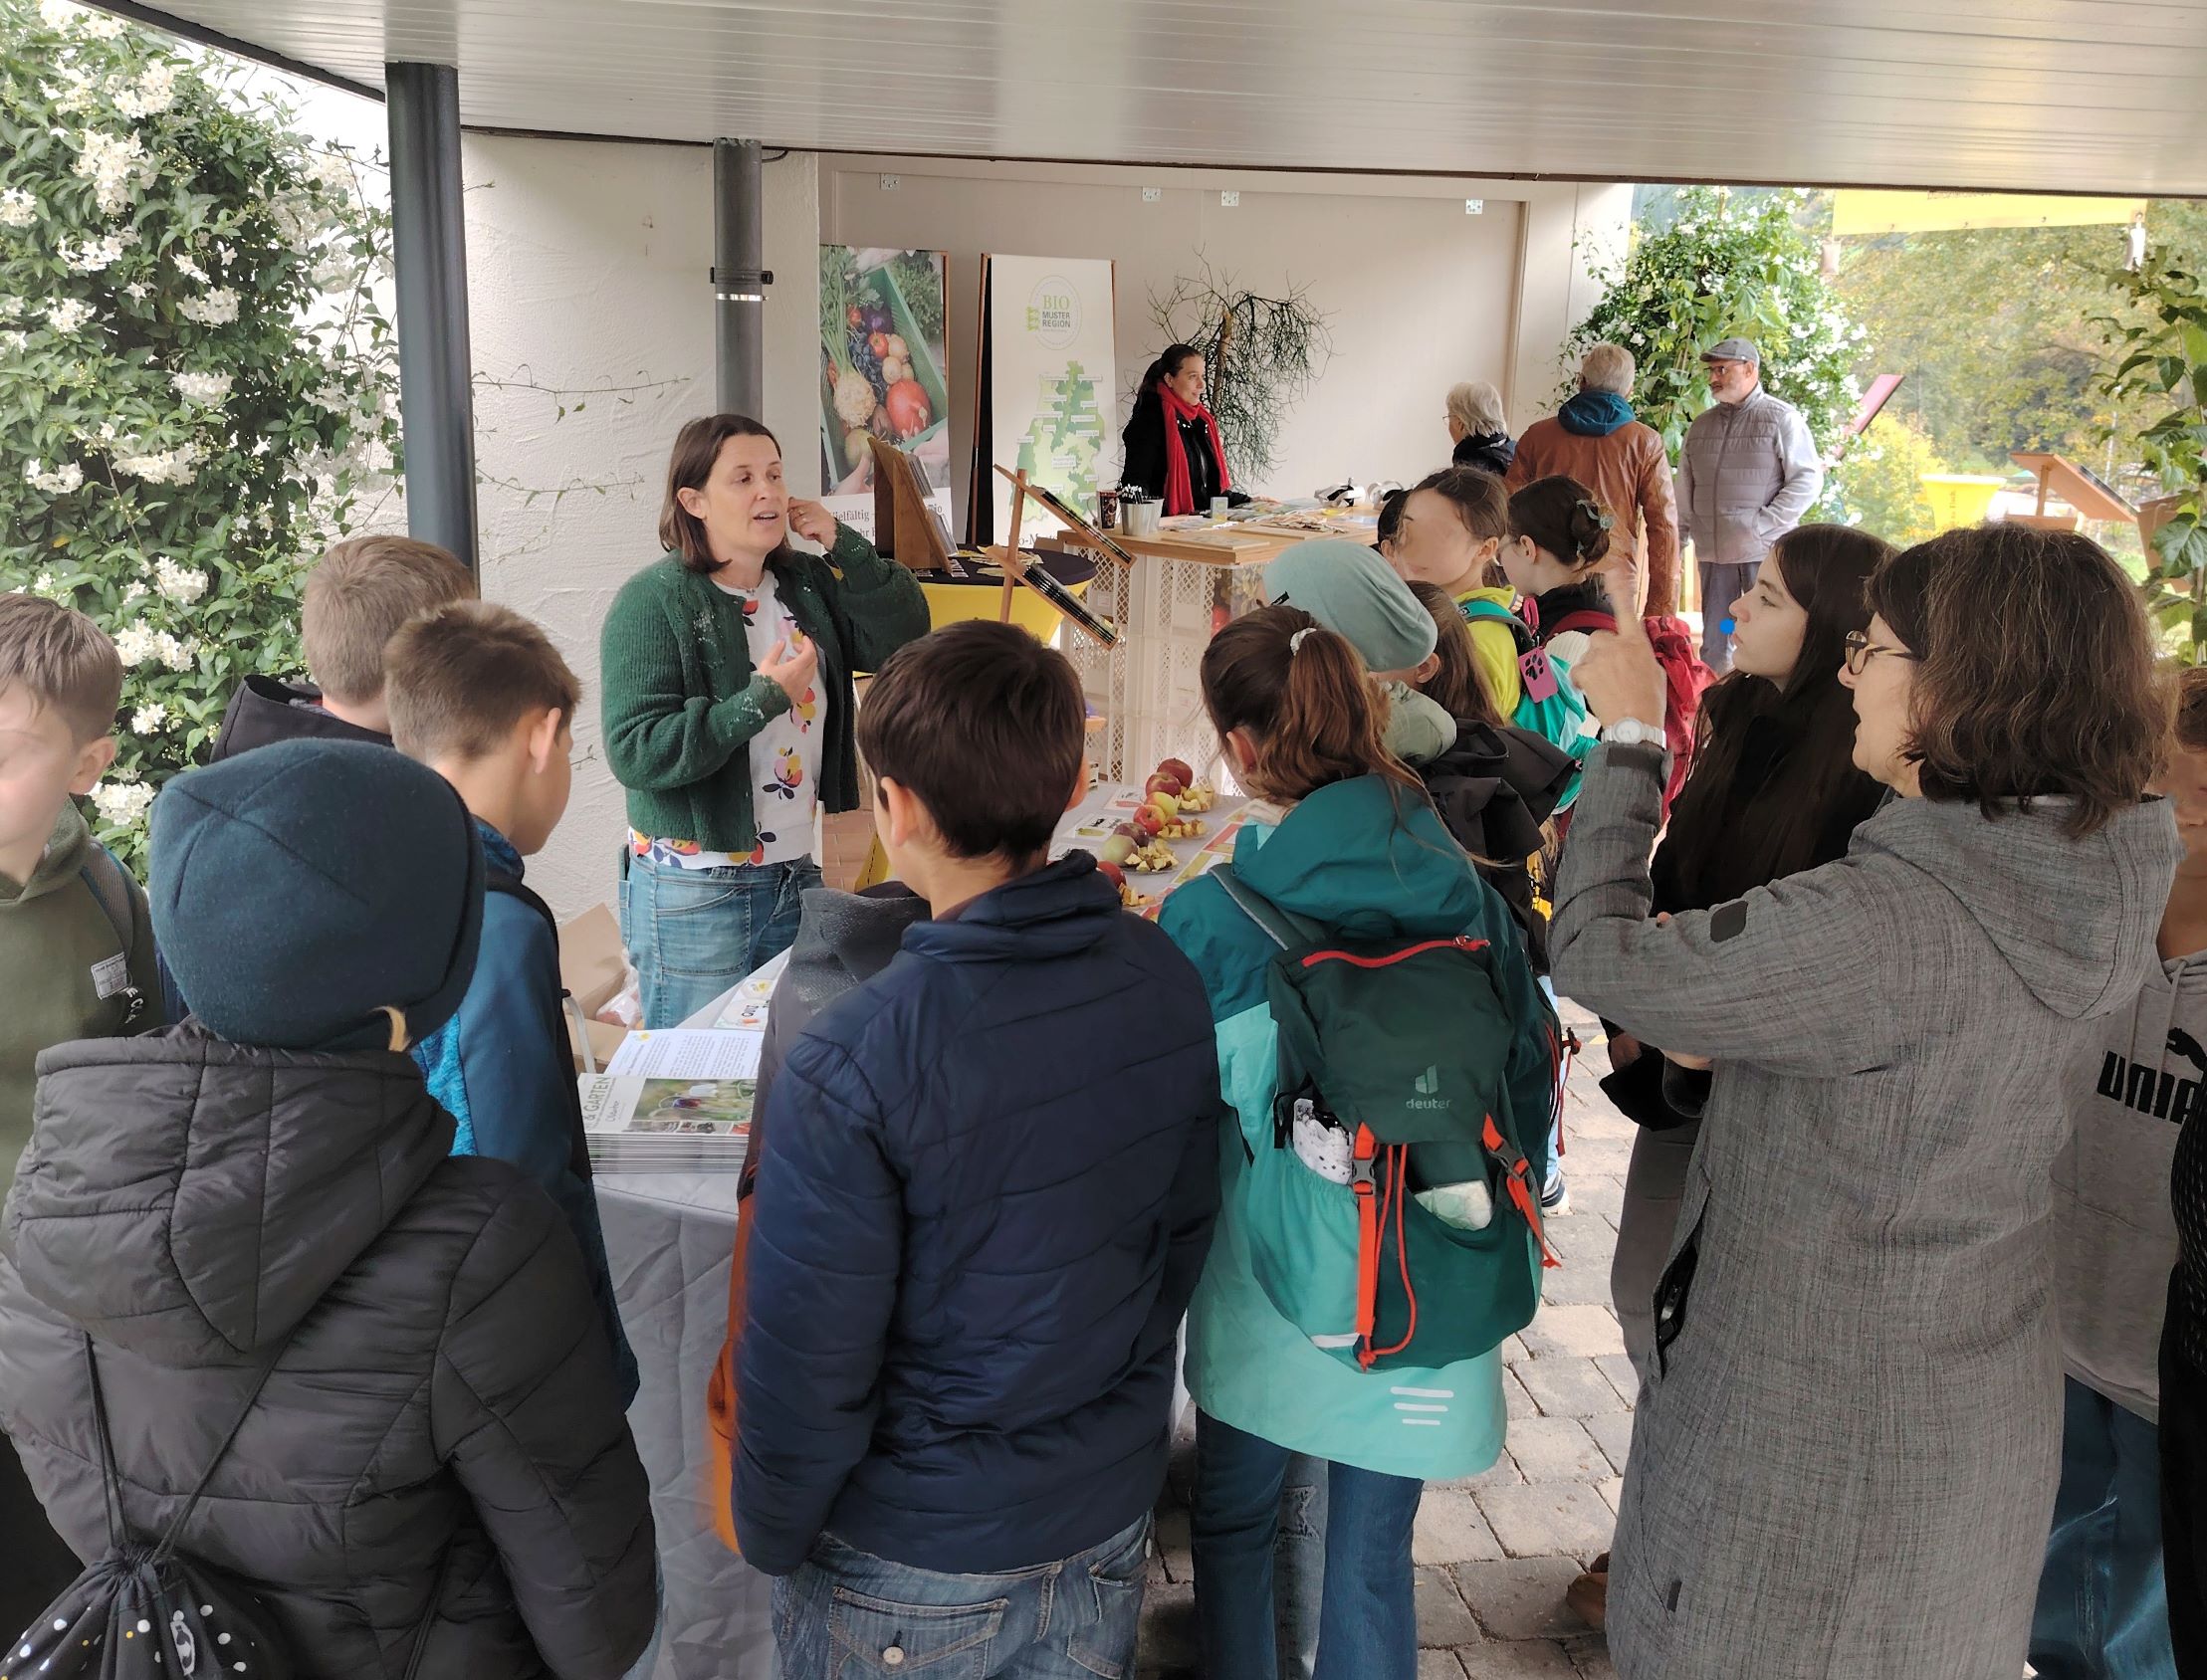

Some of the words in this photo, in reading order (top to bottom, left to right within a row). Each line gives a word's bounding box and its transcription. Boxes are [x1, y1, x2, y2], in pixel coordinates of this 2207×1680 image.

[1042, 295, 1070, 310] BIO
[832, 510, 870, 522] ielfältig
[583, 1077, 612, 1112] GARTEN
[1406, 1098, 1450, 1110] deuter
